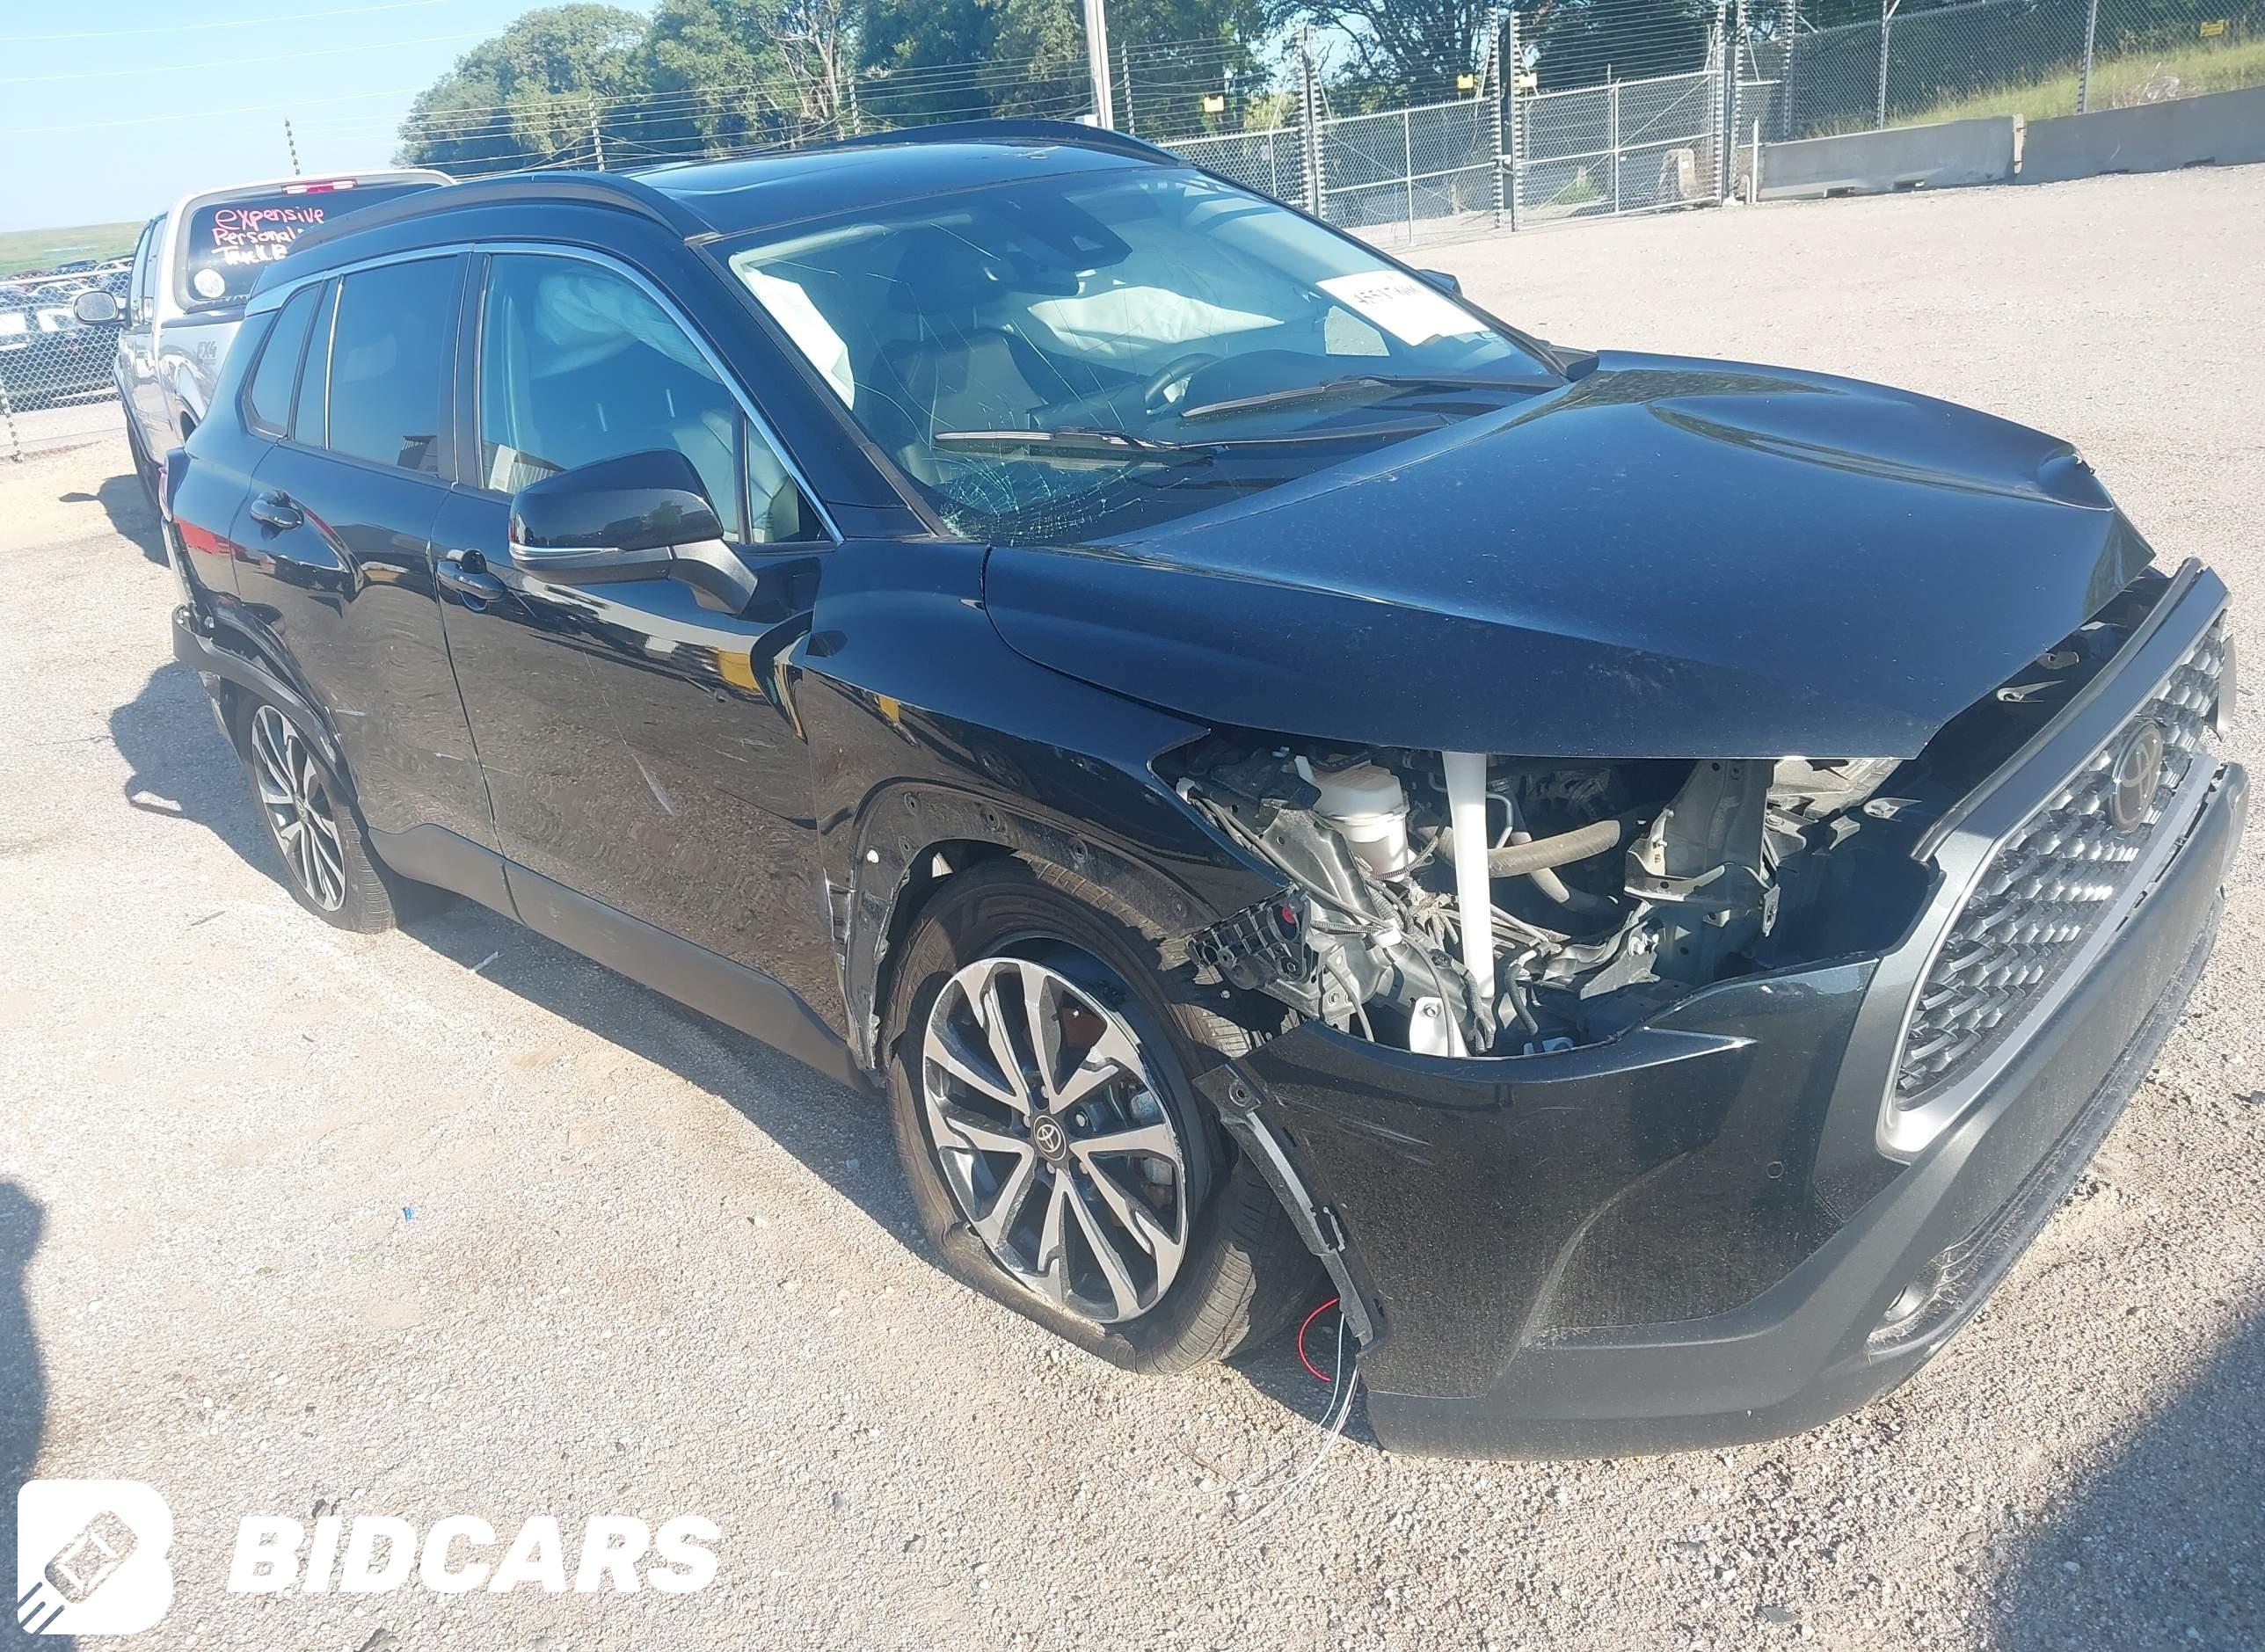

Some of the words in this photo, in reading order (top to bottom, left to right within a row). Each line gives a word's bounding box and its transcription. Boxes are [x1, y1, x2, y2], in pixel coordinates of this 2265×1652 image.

[215, 206, 324, 231] expensive
[212, 226, 296, 246] Personal
[196, 340, 217, 359] FX4
